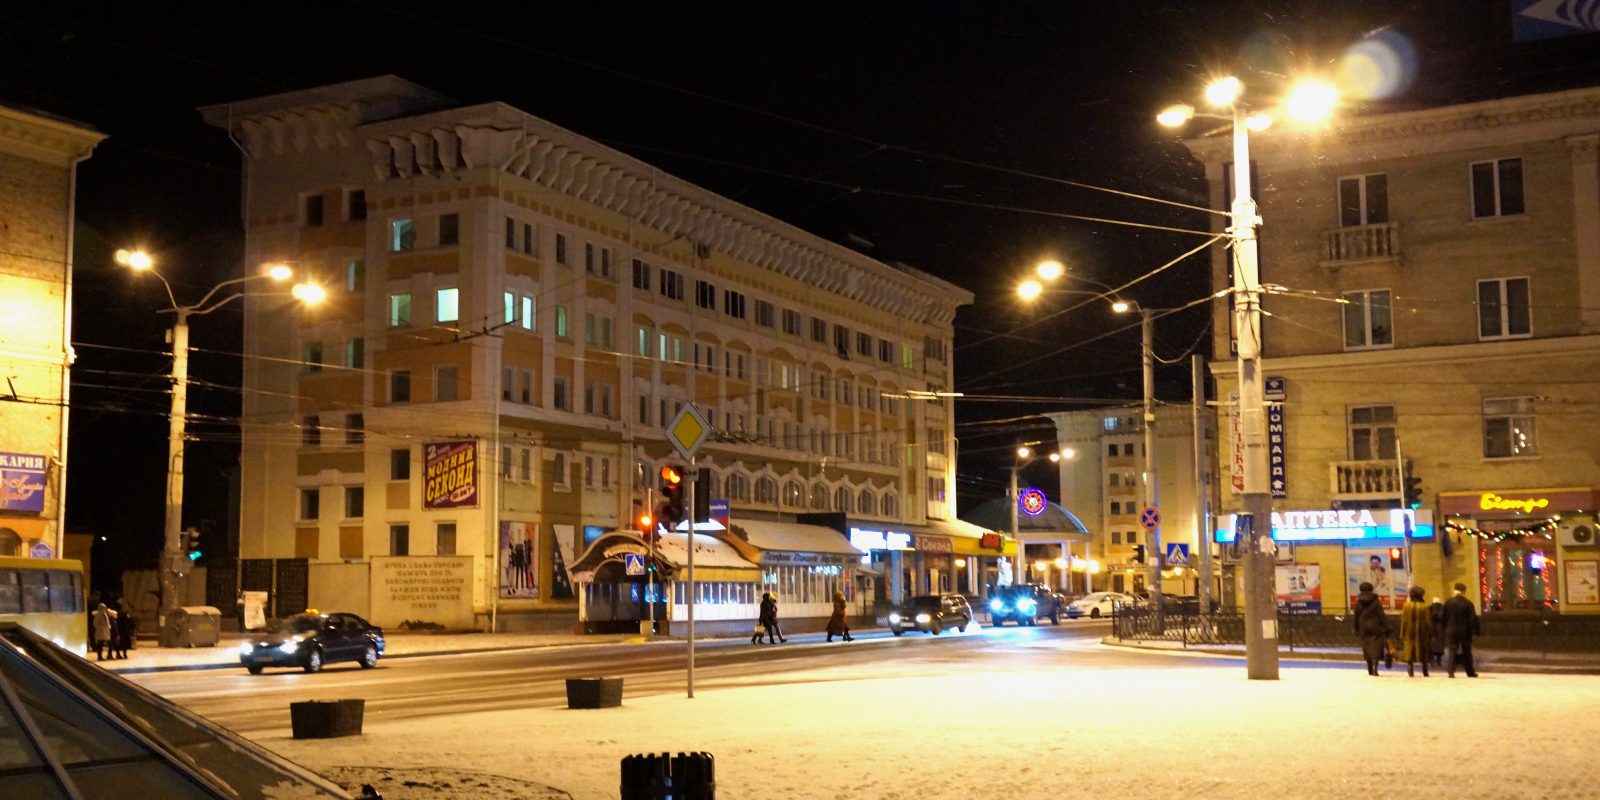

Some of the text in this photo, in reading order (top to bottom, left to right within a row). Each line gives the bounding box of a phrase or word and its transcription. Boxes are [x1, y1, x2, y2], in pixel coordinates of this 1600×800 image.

[1269, 402, 1283, 476] ЛОМБАРД
[427, 461, 475, 502] СЕКОНД
[1271, 509, 1377, 529] АПТЕКА
